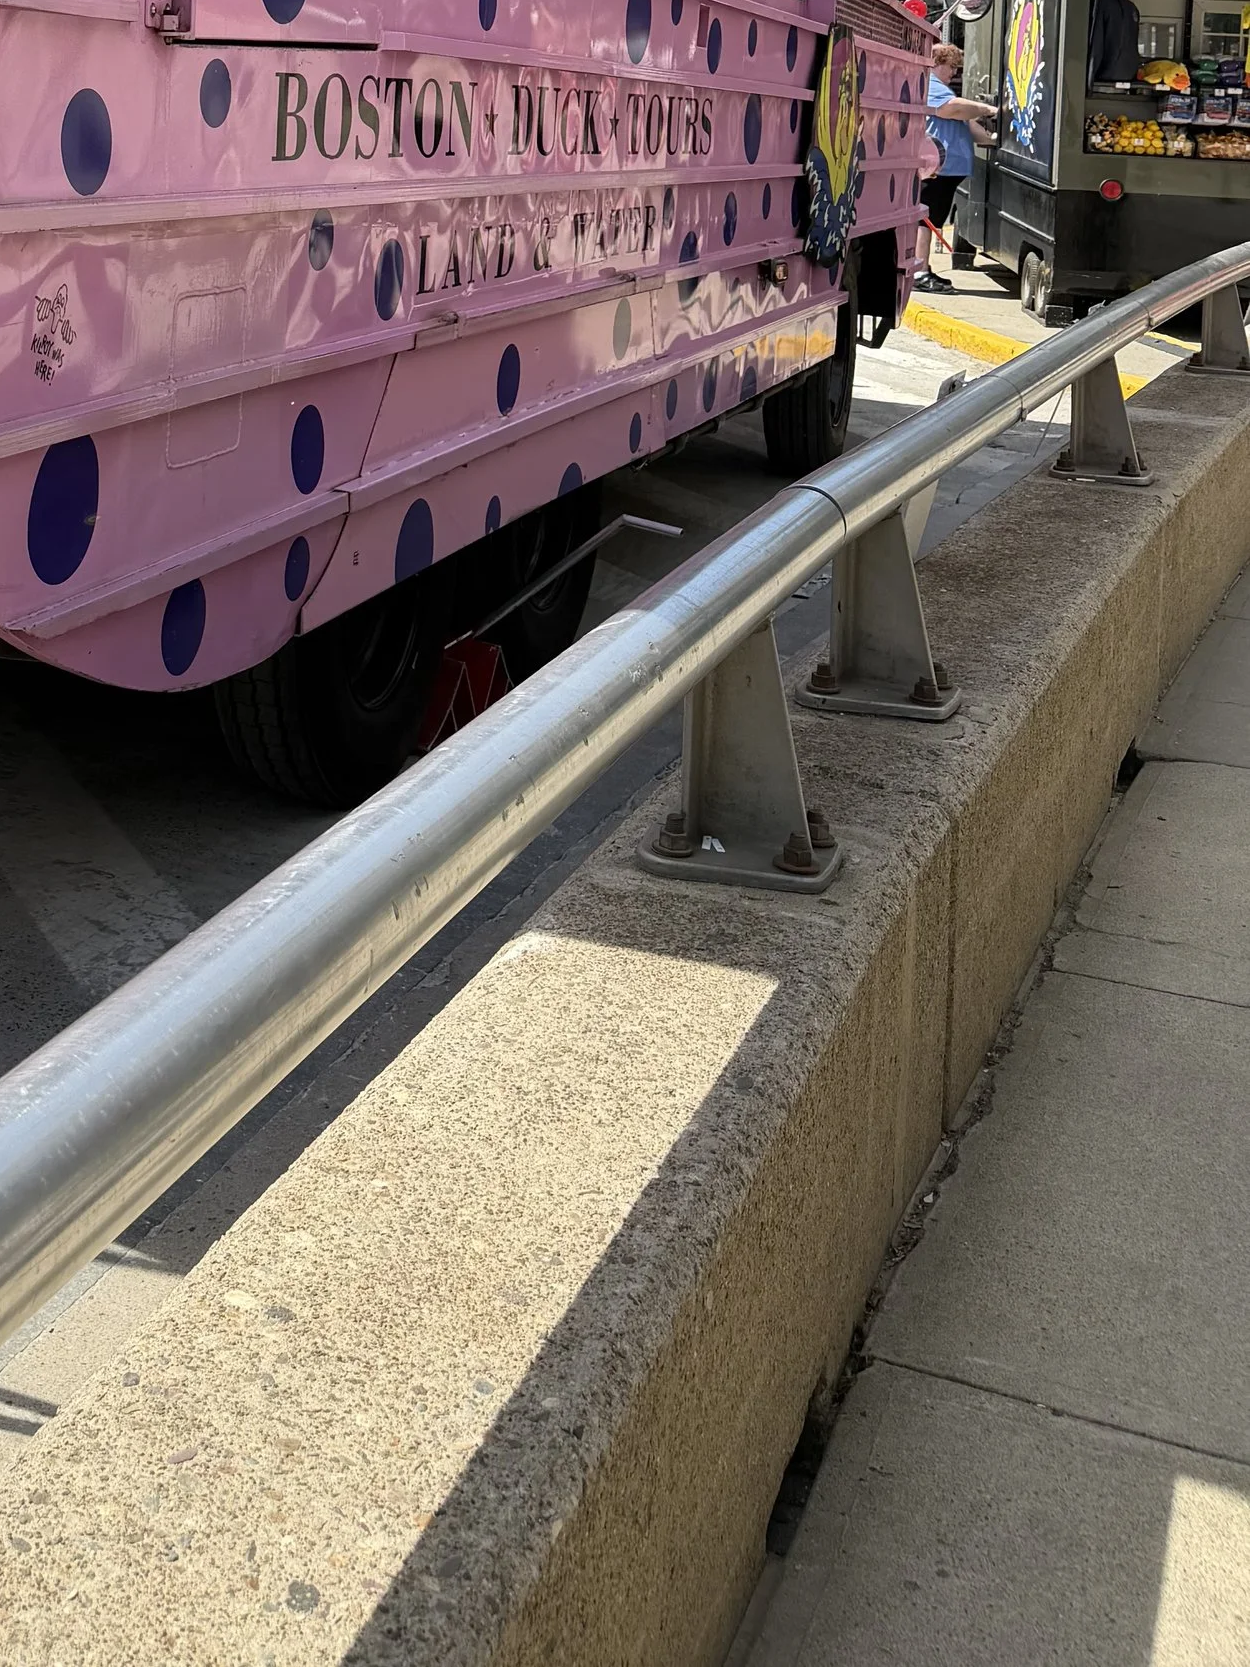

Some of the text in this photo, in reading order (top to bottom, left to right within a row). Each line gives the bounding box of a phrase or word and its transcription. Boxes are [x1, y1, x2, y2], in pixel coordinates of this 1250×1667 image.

[271, 71, 714, 161] BOSTON DUCK TOURS
[415, 205, 657, 295] LAND & WATER
[52, 349, 65, 368] WAS
